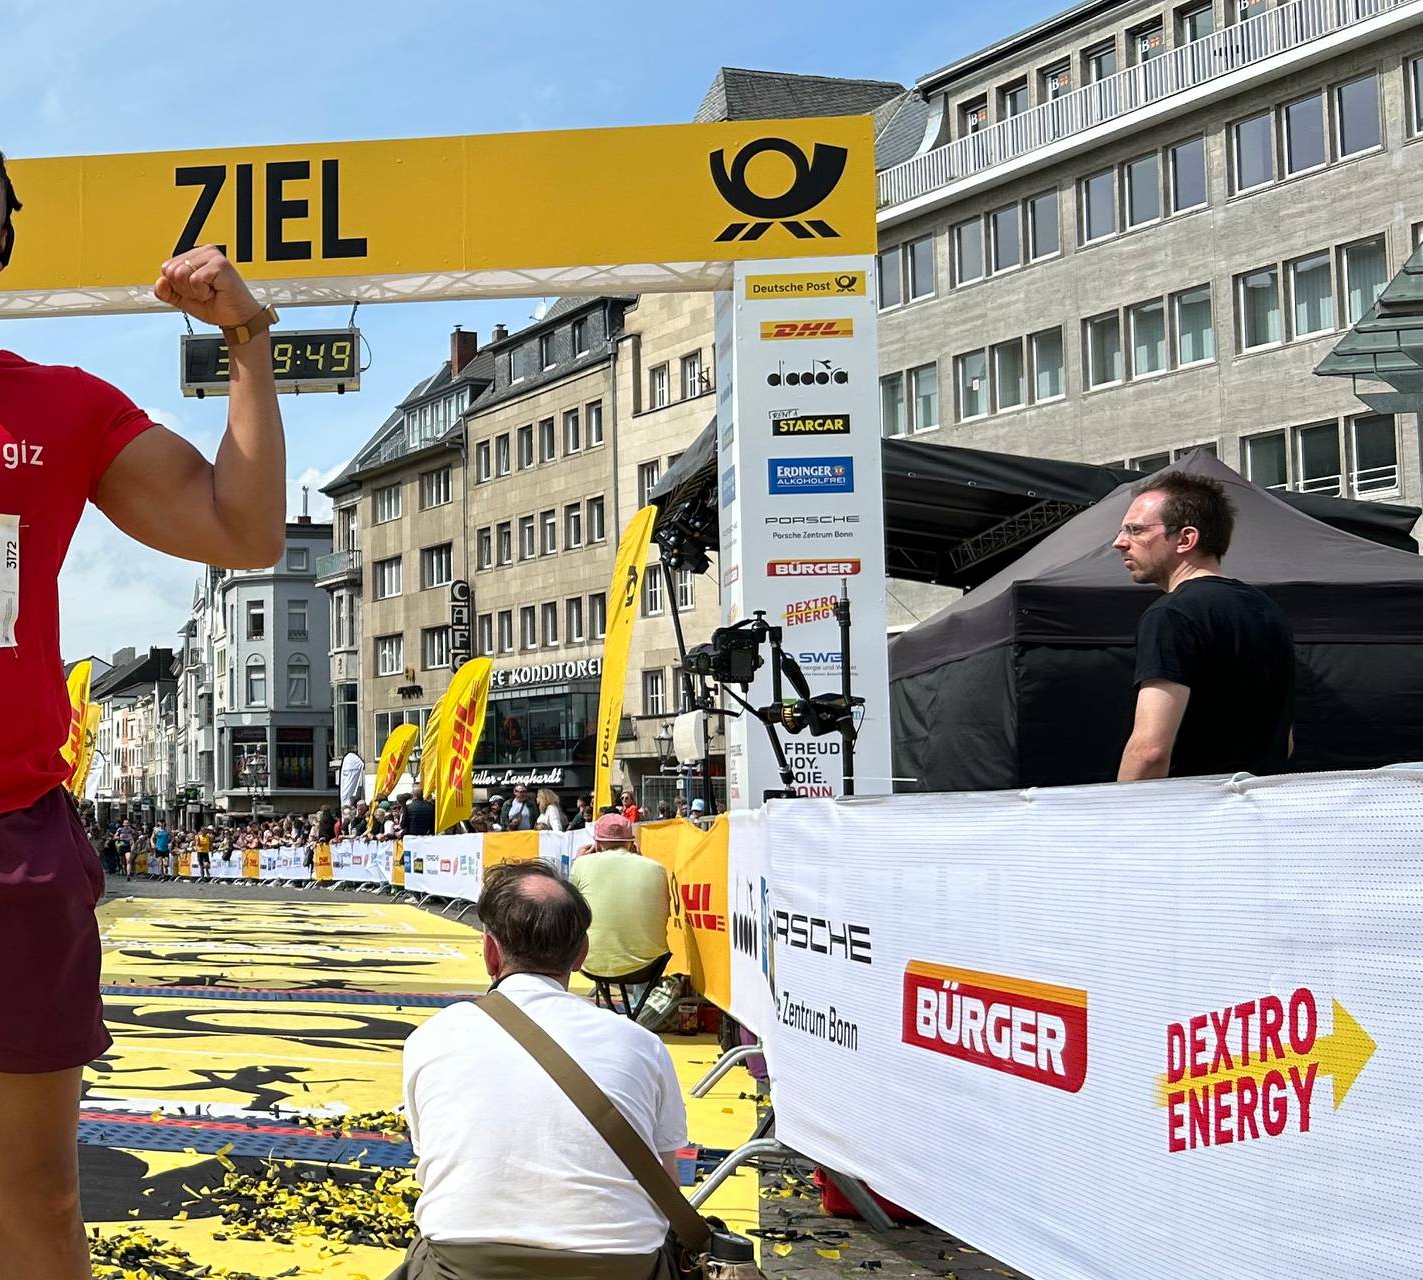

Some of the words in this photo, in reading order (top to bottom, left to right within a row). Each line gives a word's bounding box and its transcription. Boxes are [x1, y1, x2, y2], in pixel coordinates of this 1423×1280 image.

[173, 158, 368, 263] ZIEL
[752, 282, 804, 294] Deutsche
[806, 280, 831, 292] Post
[772, 322, 842, 337] DHL
[766, 359, 850, 387] diadora
[779, 418, 844, 432] STARCAR
[2, 439, 44, 470] giz
[776, 465, 833, 478] ERDINGER
[777, 476, 846, 485] ALKOHOLFREI
[765, 515, 860, 525] PORSCHE
[772, 531, 801, 540] Porsche
[802, 531, 832, 539] Zentrum
[834, 530, 854, 538] Bonn
[6, 540, 17, 569] 3172
[774, 561, 853, 575] BÜRGER
[785, 595, 838, 614] DEXTRO
[786, 608, 838, 627] ENERGY
[511, 657, 602, 684] KONDITOREI
[784, 742, 856, 755] FREUD.
[795, 772, 827, 784] OIE.
[772, 909, 872, 965] RSCHE
[782, 991, 826, 1039] Zentrum
[829, 1006, 858, 1051] Bonn
[915, 978, 1067, 1078] BÜRGER
[1165, 986, 1318, 1085] DEXTRO
[1166, 1060, 1320, 1154] ENERGY
